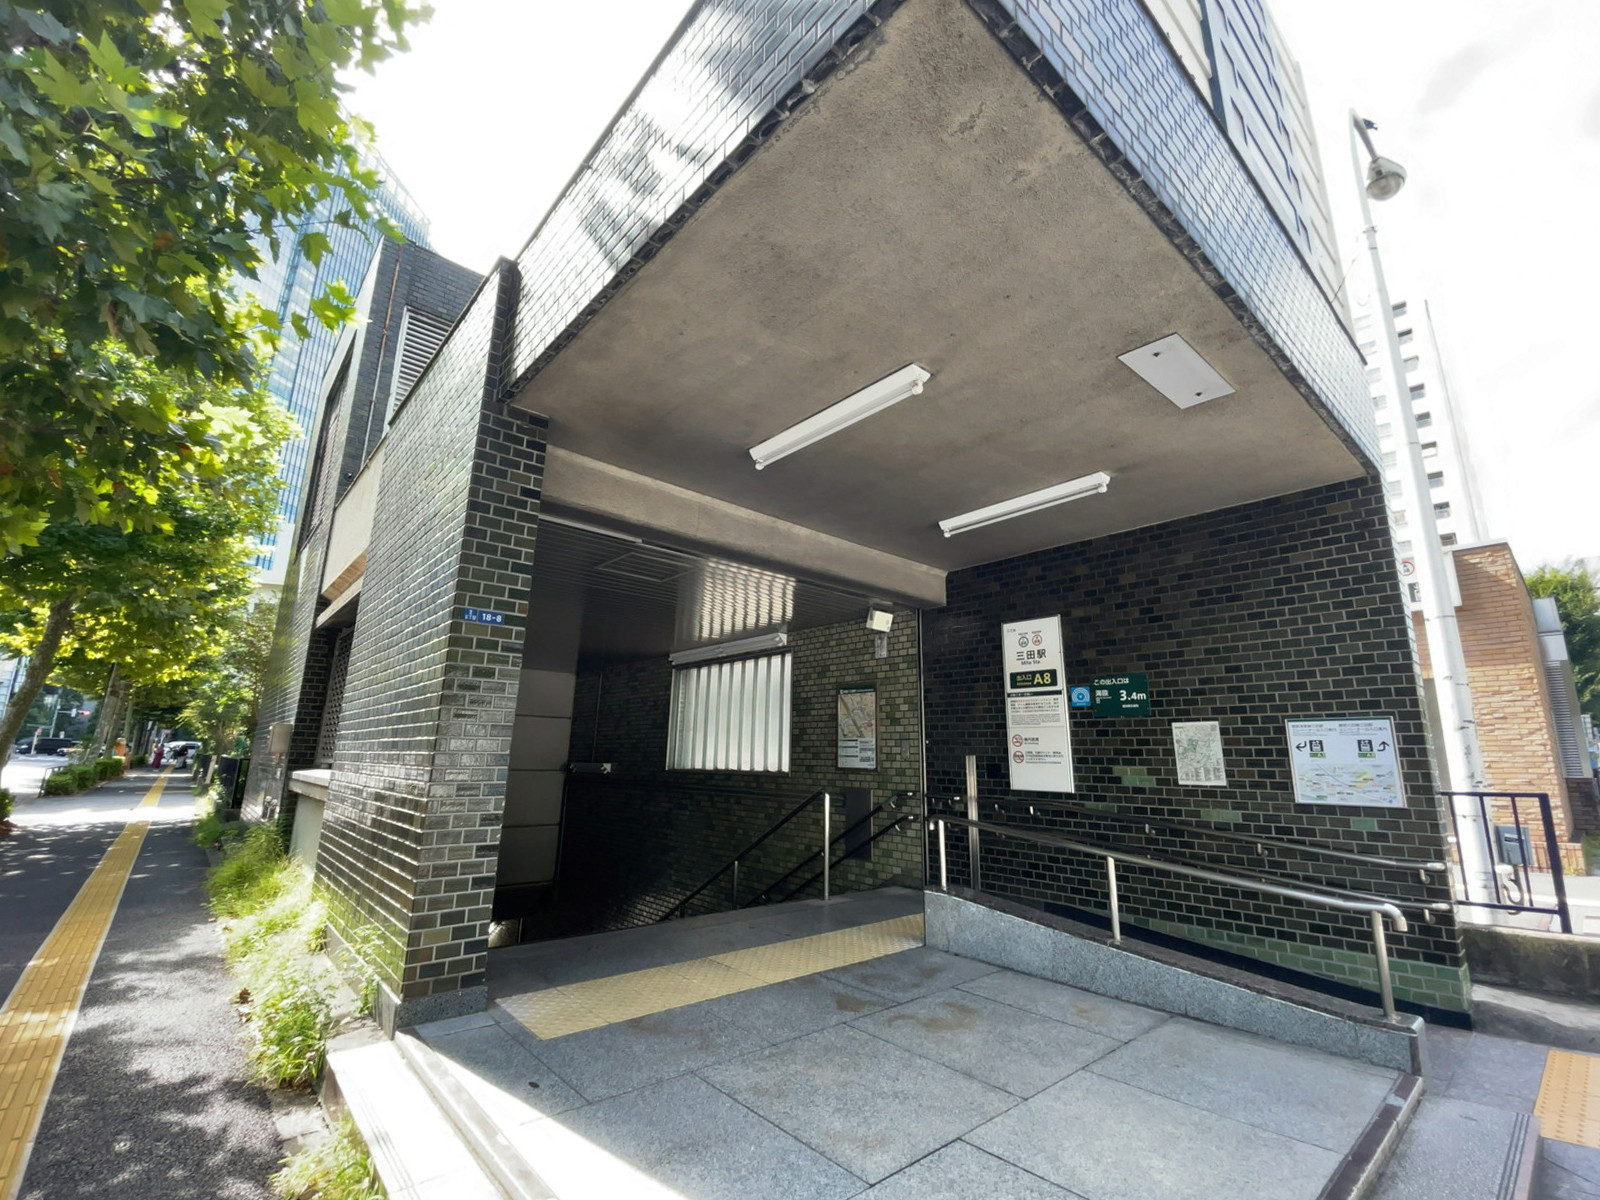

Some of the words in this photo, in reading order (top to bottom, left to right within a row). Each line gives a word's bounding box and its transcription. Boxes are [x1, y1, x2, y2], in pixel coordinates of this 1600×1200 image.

[1016, 649, 1046, 660] 三田駅
[1034, 672, 1051, 684] A8
[1120, 690, 1146, 700] 3.4m
